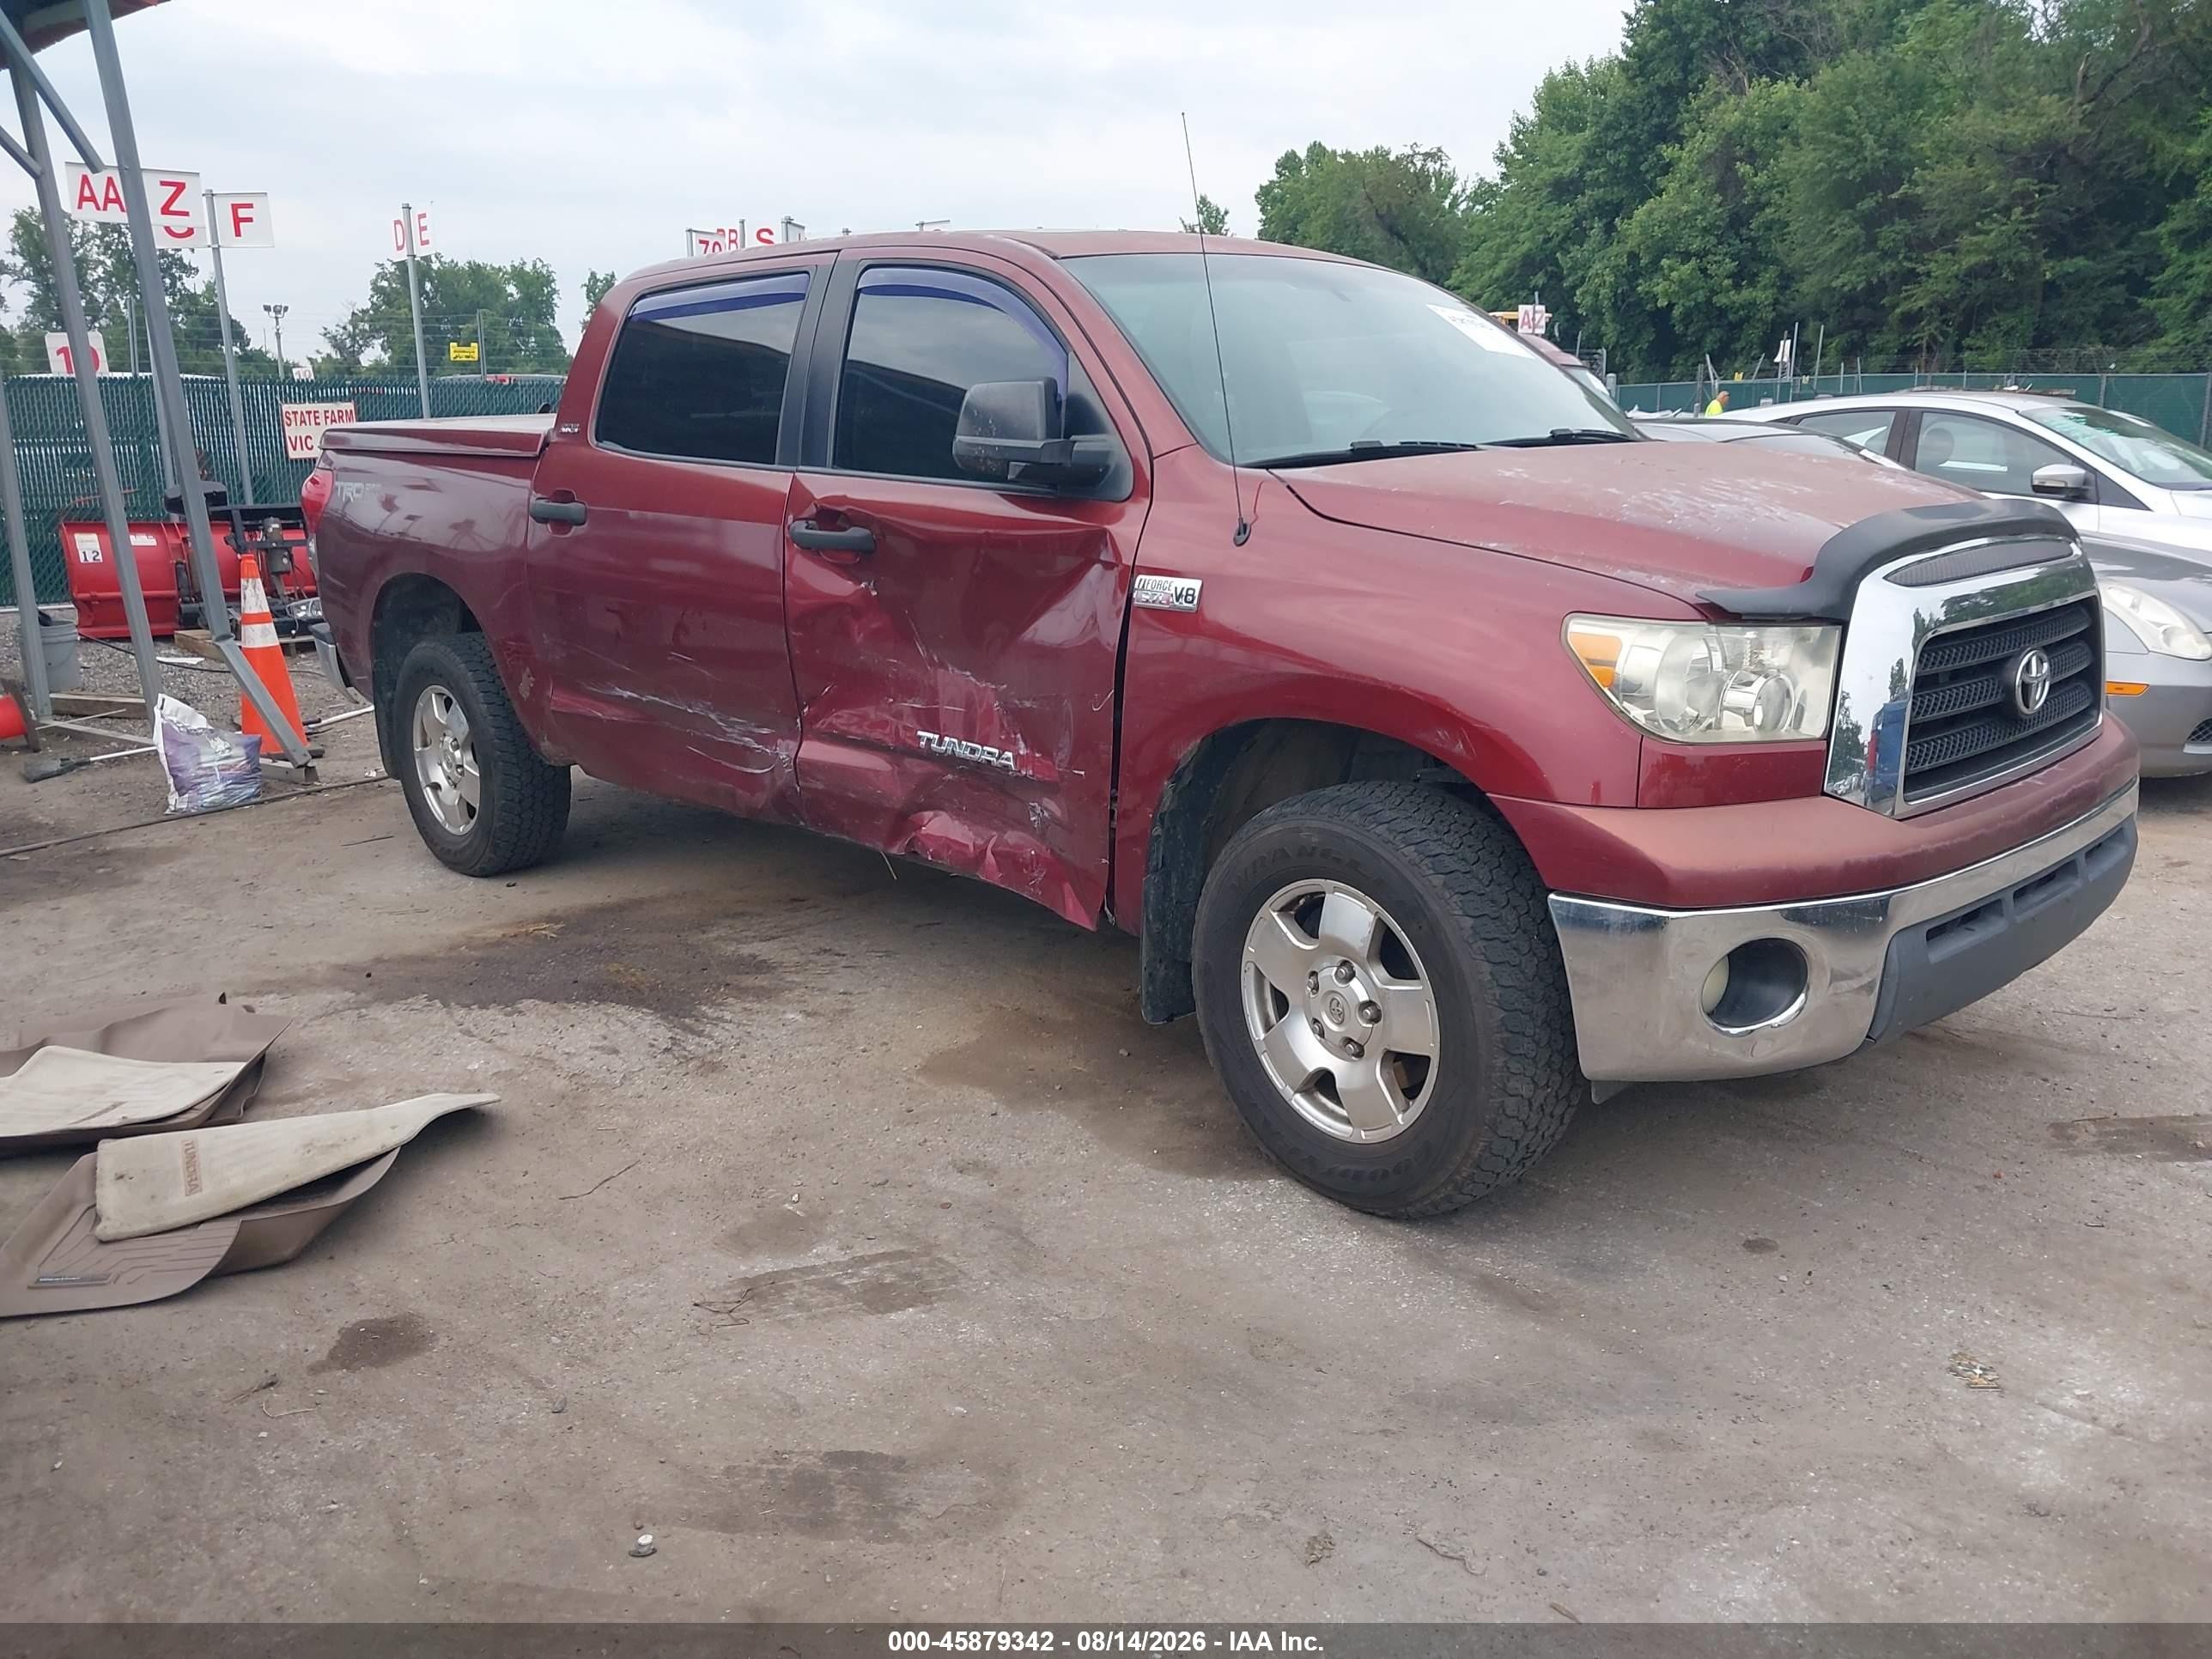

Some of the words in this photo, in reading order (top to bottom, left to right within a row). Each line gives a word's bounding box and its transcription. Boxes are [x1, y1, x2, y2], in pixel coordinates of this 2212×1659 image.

[77, 174, 127, 213] AA
[159, 180, 190, 216] Z
[231, 203, 254, 238] F
[393, 219, 405, 251] D
[417, 213, 429, 246] E
[284, 410, 321, 427] STATE
[324, 408, 355, 425] FARM
[289, 434, 314, 452] VIC
[1174, 586, 1197, 605] V8
[916, 730, 1015, 771] TUNDRA
